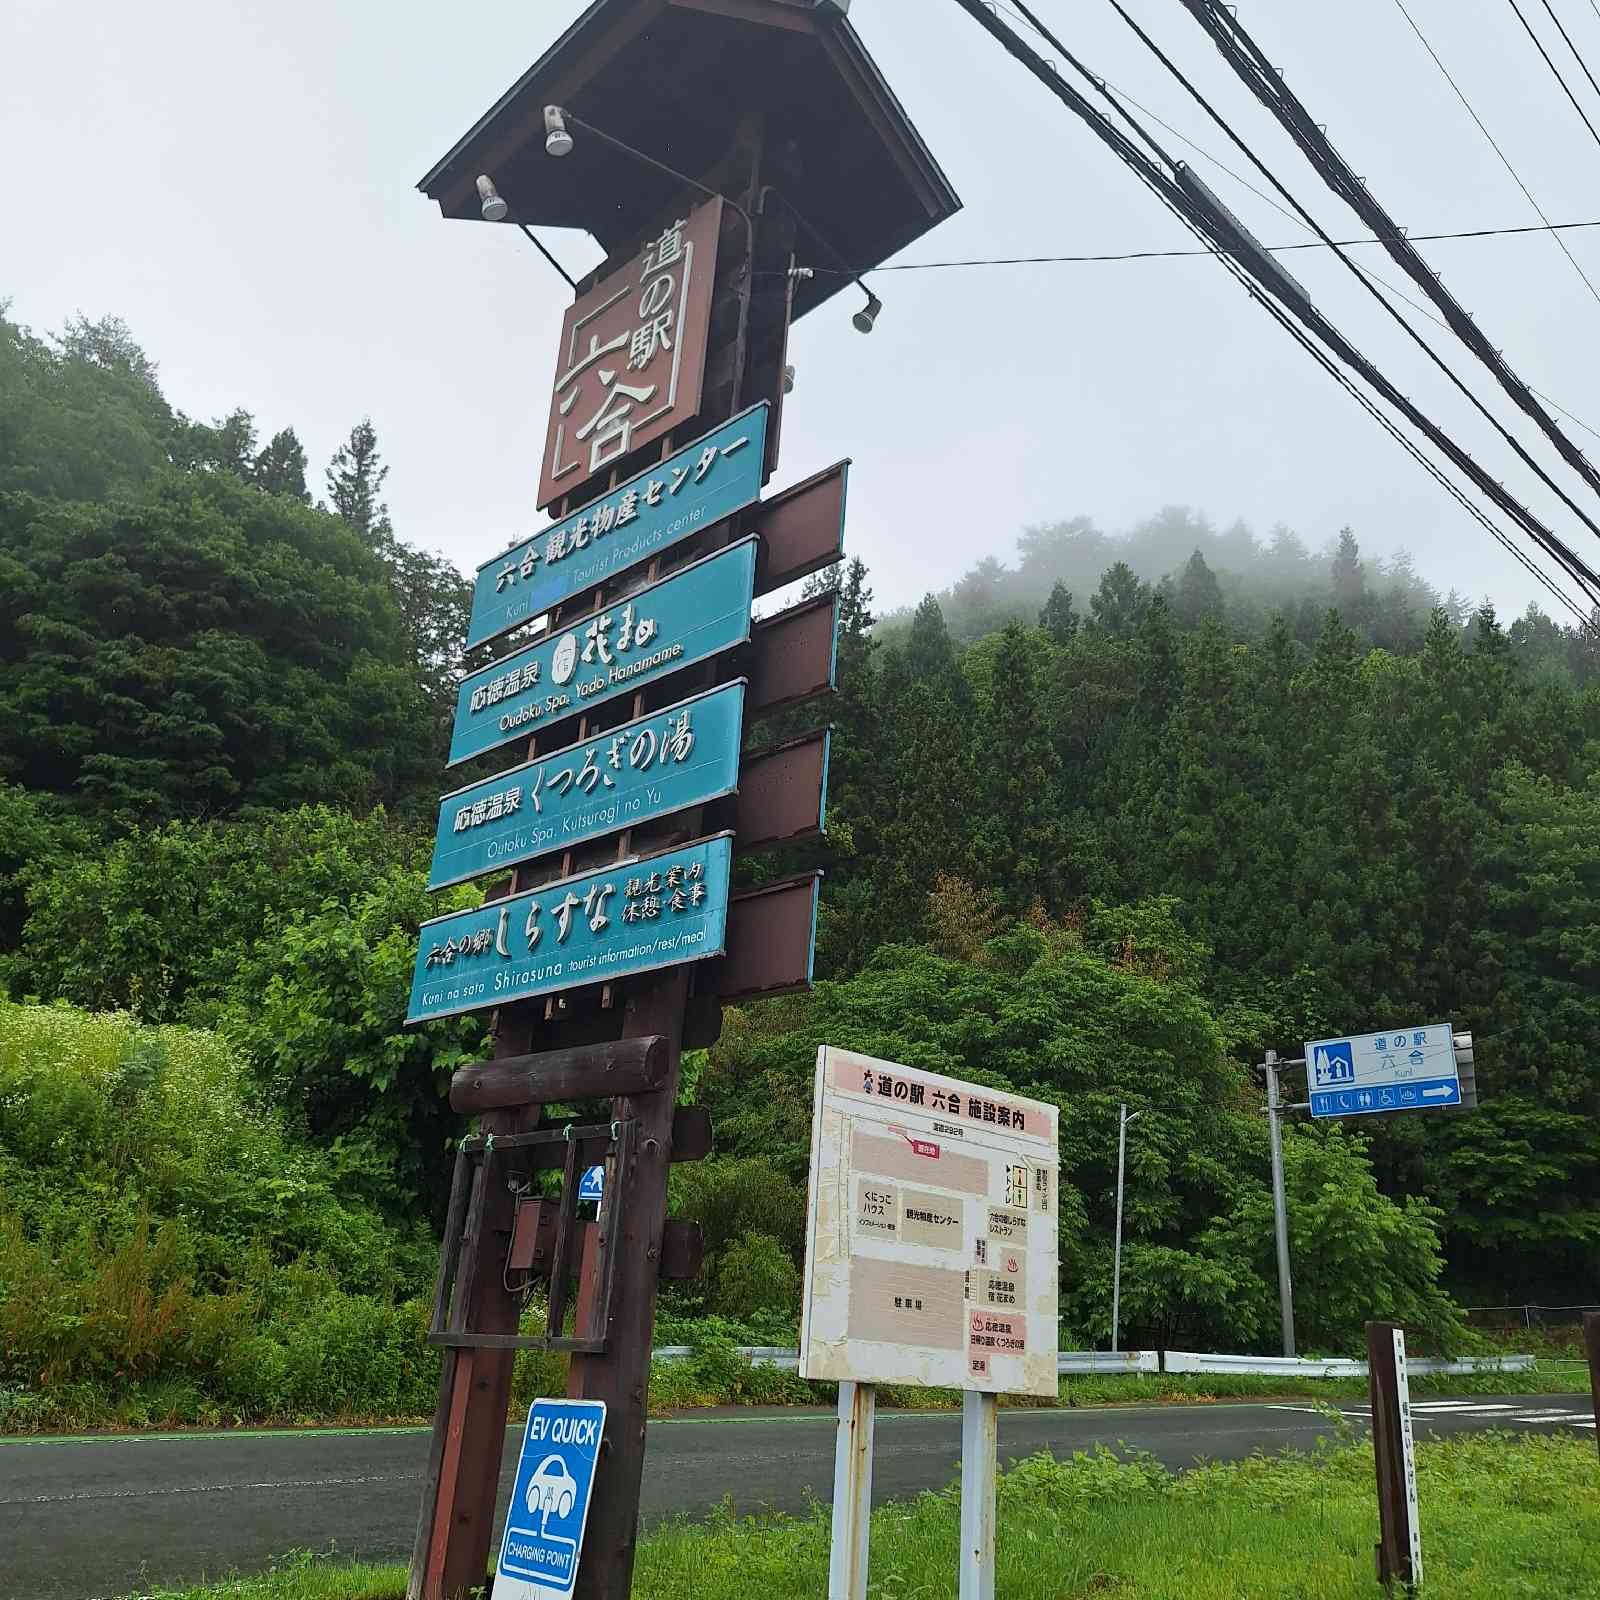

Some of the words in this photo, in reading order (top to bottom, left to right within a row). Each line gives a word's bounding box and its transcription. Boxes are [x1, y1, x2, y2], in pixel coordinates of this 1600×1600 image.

[627, 219, 689, 370] 道の駅
[555, 331, 658, 474] 六合
[496, 436, 750, 593] 六合観光物産センター
[572, 557, 609, 583] Tourist
[612, 526, 663, 563] Products
[666, 505, 707, 535] center
[609, 643, 684, 682] Hanamame
[470, 660, 542, 713] 応徳温泉
[454, 786, 523, 833] 応徳温泉
[531, 710, 694, 814] くつろぎの湯
[562, 802, 623, 833] Kutsurogi
[624, 797, 640, 812] no
[647, 788, 661, 806] Yu
[624, 862, 705, 898] 観光案内
[424, 927, 494, 970] 六合の郷
[496, 883, 616, 958] しらすな
[422, 986, 443, 1006] Kuni
[463, 982, 485, 998] sato
[494, 961, 562, 991] Shirasuna
[1375, 1031, 1428, 1051] 道の駅
[1380, 1050, 1424, 1070] 六合
[878, 1074, 925, 1106] 道の駅
[931, 1090, 961, 1115] 六合
[968, 1097, 1025, 1131] 施設案内
[863, 1203, 885, 1216] ハウス
[864, 1191, 892, 1205] くにっこ
[906, 1208, 959, 1226] 観光物産センター
[990, 1225, 1013, 1236] レストラン
[530, 1416, 551, 1441] EV
[552, 1418, 598, 1446] QUICK
[507, 1542, 545, 1563] CHARGING
[546, 1551, 571, 1570] POINT
